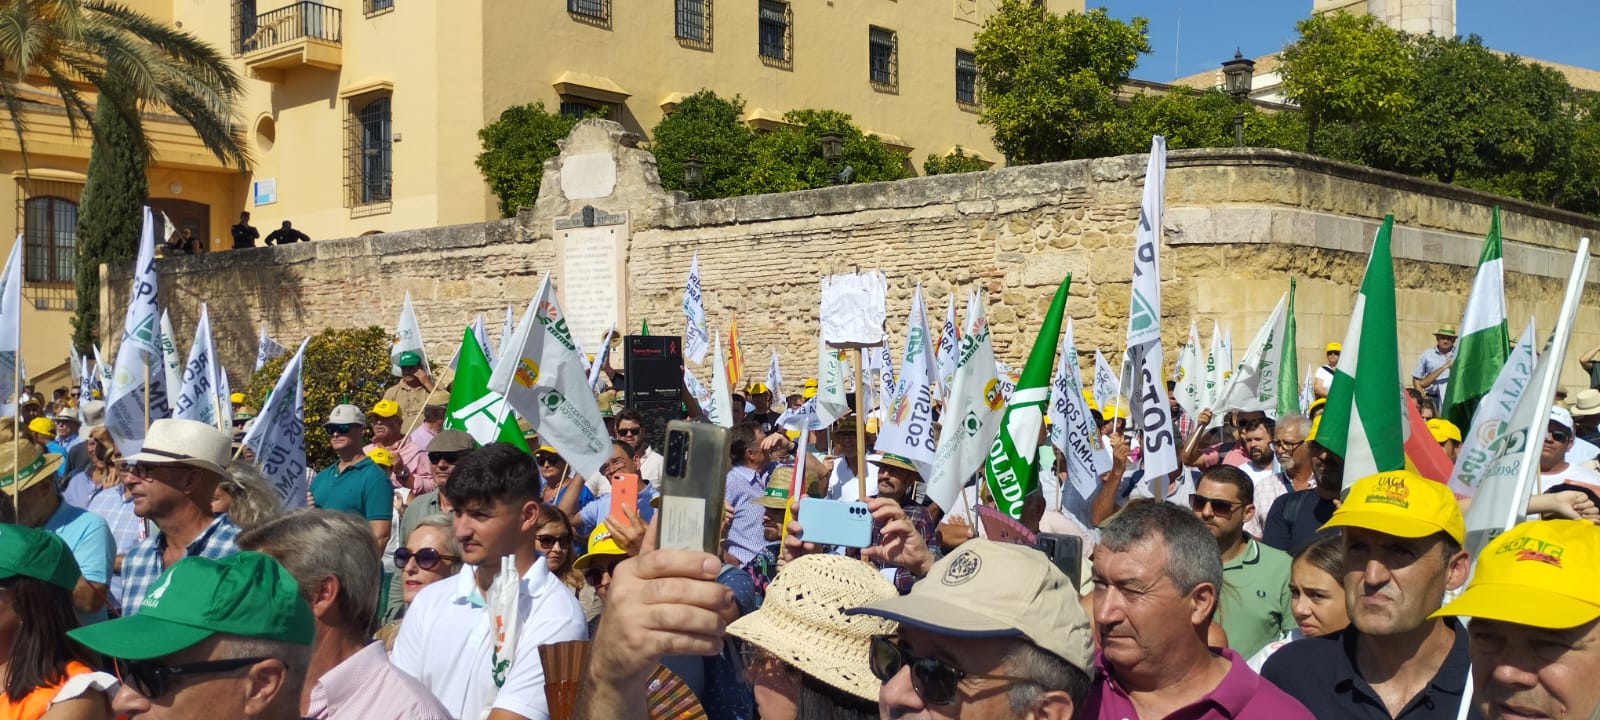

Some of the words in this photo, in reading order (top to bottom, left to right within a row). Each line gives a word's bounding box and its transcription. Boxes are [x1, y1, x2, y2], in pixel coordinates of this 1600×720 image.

[882, 372, 896, 394] CAM
[988, 432, 1024, 520] OLEDO
[1496, 537, 1564, 558] COAG
